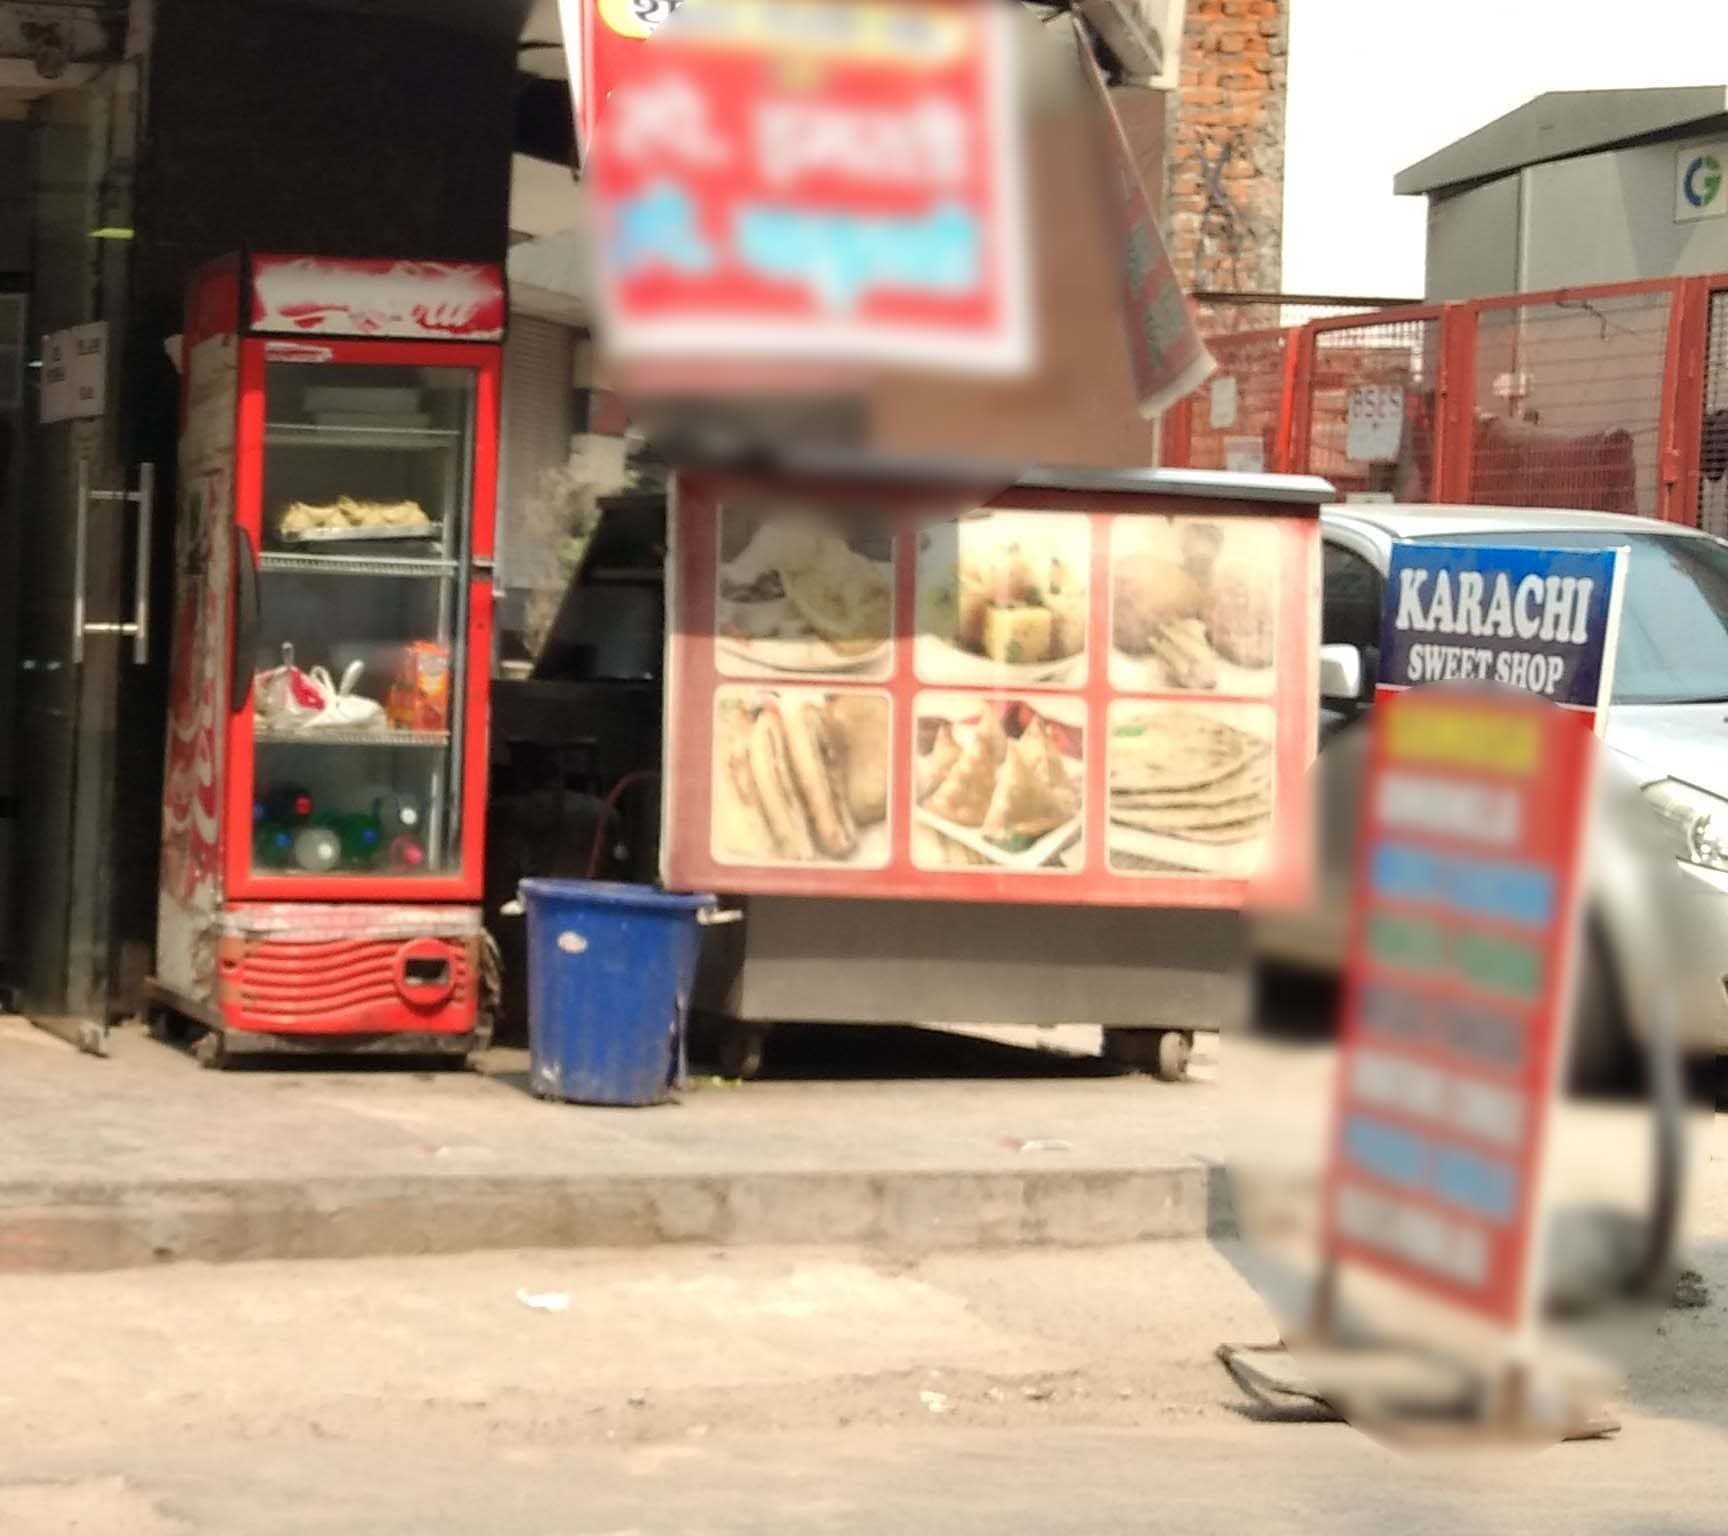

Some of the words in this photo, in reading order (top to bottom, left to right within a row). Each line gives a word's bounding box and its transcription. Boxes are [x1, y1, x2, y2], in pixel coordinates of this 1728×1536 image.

[1395, 567, 1595, 645] KARACHI
[1407, 642, 1493, 681] SWEET
[1494, 650, 1565, 695] SHOP
